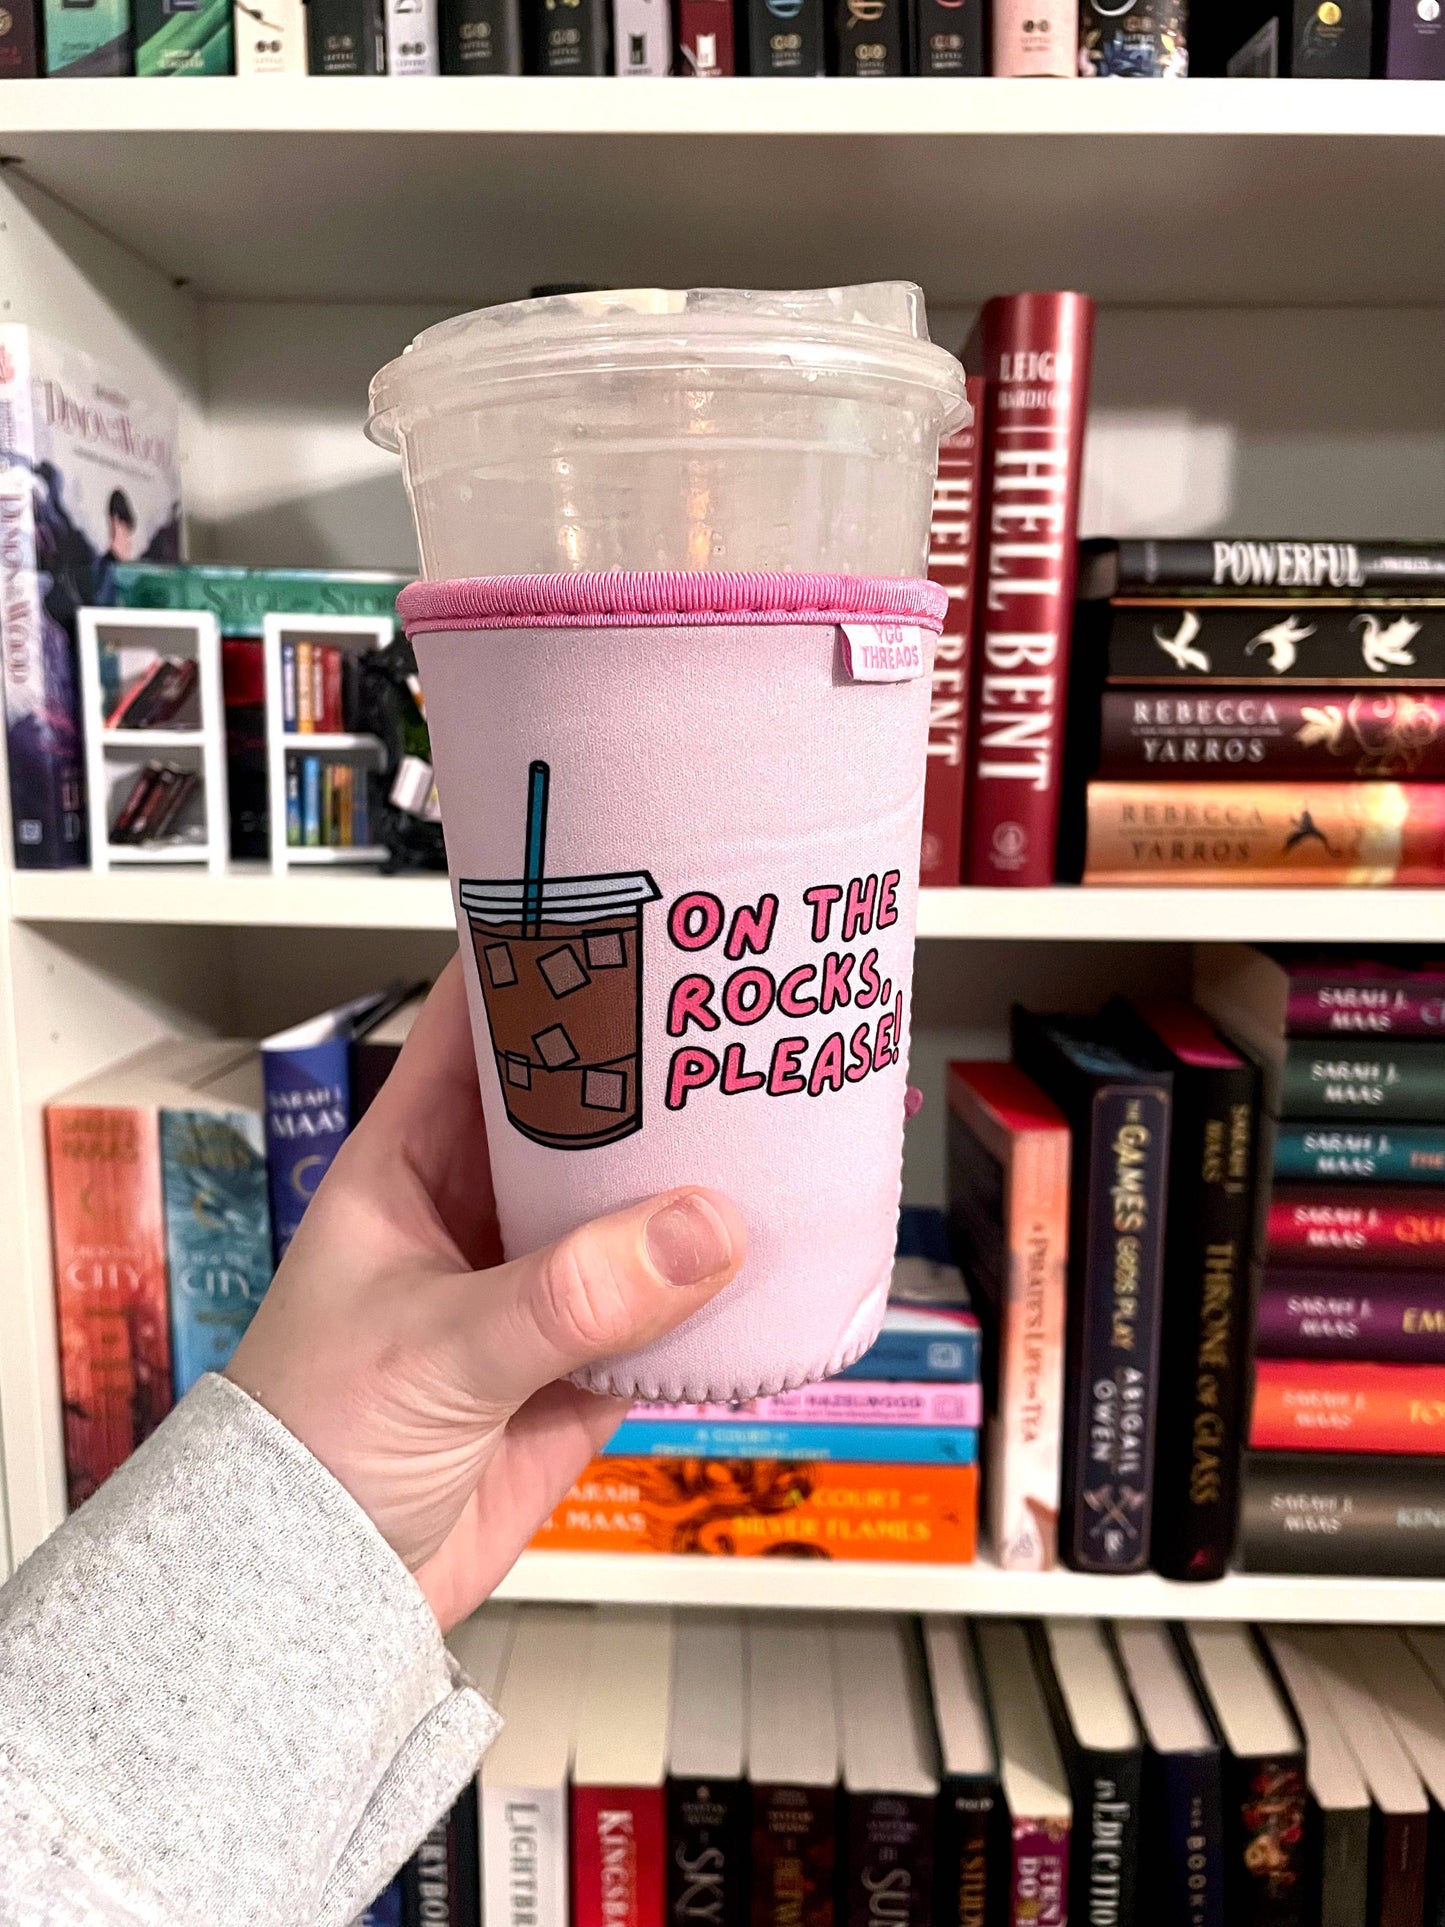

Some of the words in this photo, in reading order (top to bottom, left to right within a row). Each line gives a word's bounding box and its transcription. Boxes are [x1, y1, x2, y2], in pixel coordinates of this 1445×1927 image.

[987, 450, 1068, 611] HELL
[1213, 541, 1366, 588] POWERFUL
[860, 645, 919, 669] THREADS
[978, 632, 1057, 791] BENT
[1133, 700, 1278, 725] REBECCA
[1144, 738, 1265, 762] YARROS
[1122, 804, 1265, 826] REBECCA
[1133, 841, 1251, 863] YARROS
[667, 891, 779, 960] ON
[803, 869, 900, 942] THE
[667, 948, 891, 1036] ROCKS,
[1318, 987, 1388, 1008] SARAH
[1331, 1012, 1391, 1032] MAAS
[665, 990, 902, 1111] PLEASE!
[1311, 1060, 1380, 1081] SARAH
[1324, 1083, 1383, 1105] MAAS
[1304, 1132, 1372, 1152] SARAH
[1316, 1154, 1376, 1176] MAAS
[1110, 1123, 1151, 1232] GAMES
[1294, 1206, 1363, 1226] SARAH
[1307, 1228, 1367, 1249] MAAS
[1199, 1243, 1235, 1371] THRONE
[1287, 1297, 1355, 1316] SARAH
[1111, 1296, 1139, 1349] PLAY
[1301, 1319, 1360, 1339] MAAS
[1091, 1379, 1118, 1461] OWEN
[1118, 1367, 1144, 1475] ABIGAIL
[1190, 1412, 1224, 1504] GLASS
[563, 1482, 641, 1503] ARAH
[812, 1488, 900, 1509] COURT
[565, 1509, 647, 1535] MAAS
[674, 1841, 725, 1925] SKY
